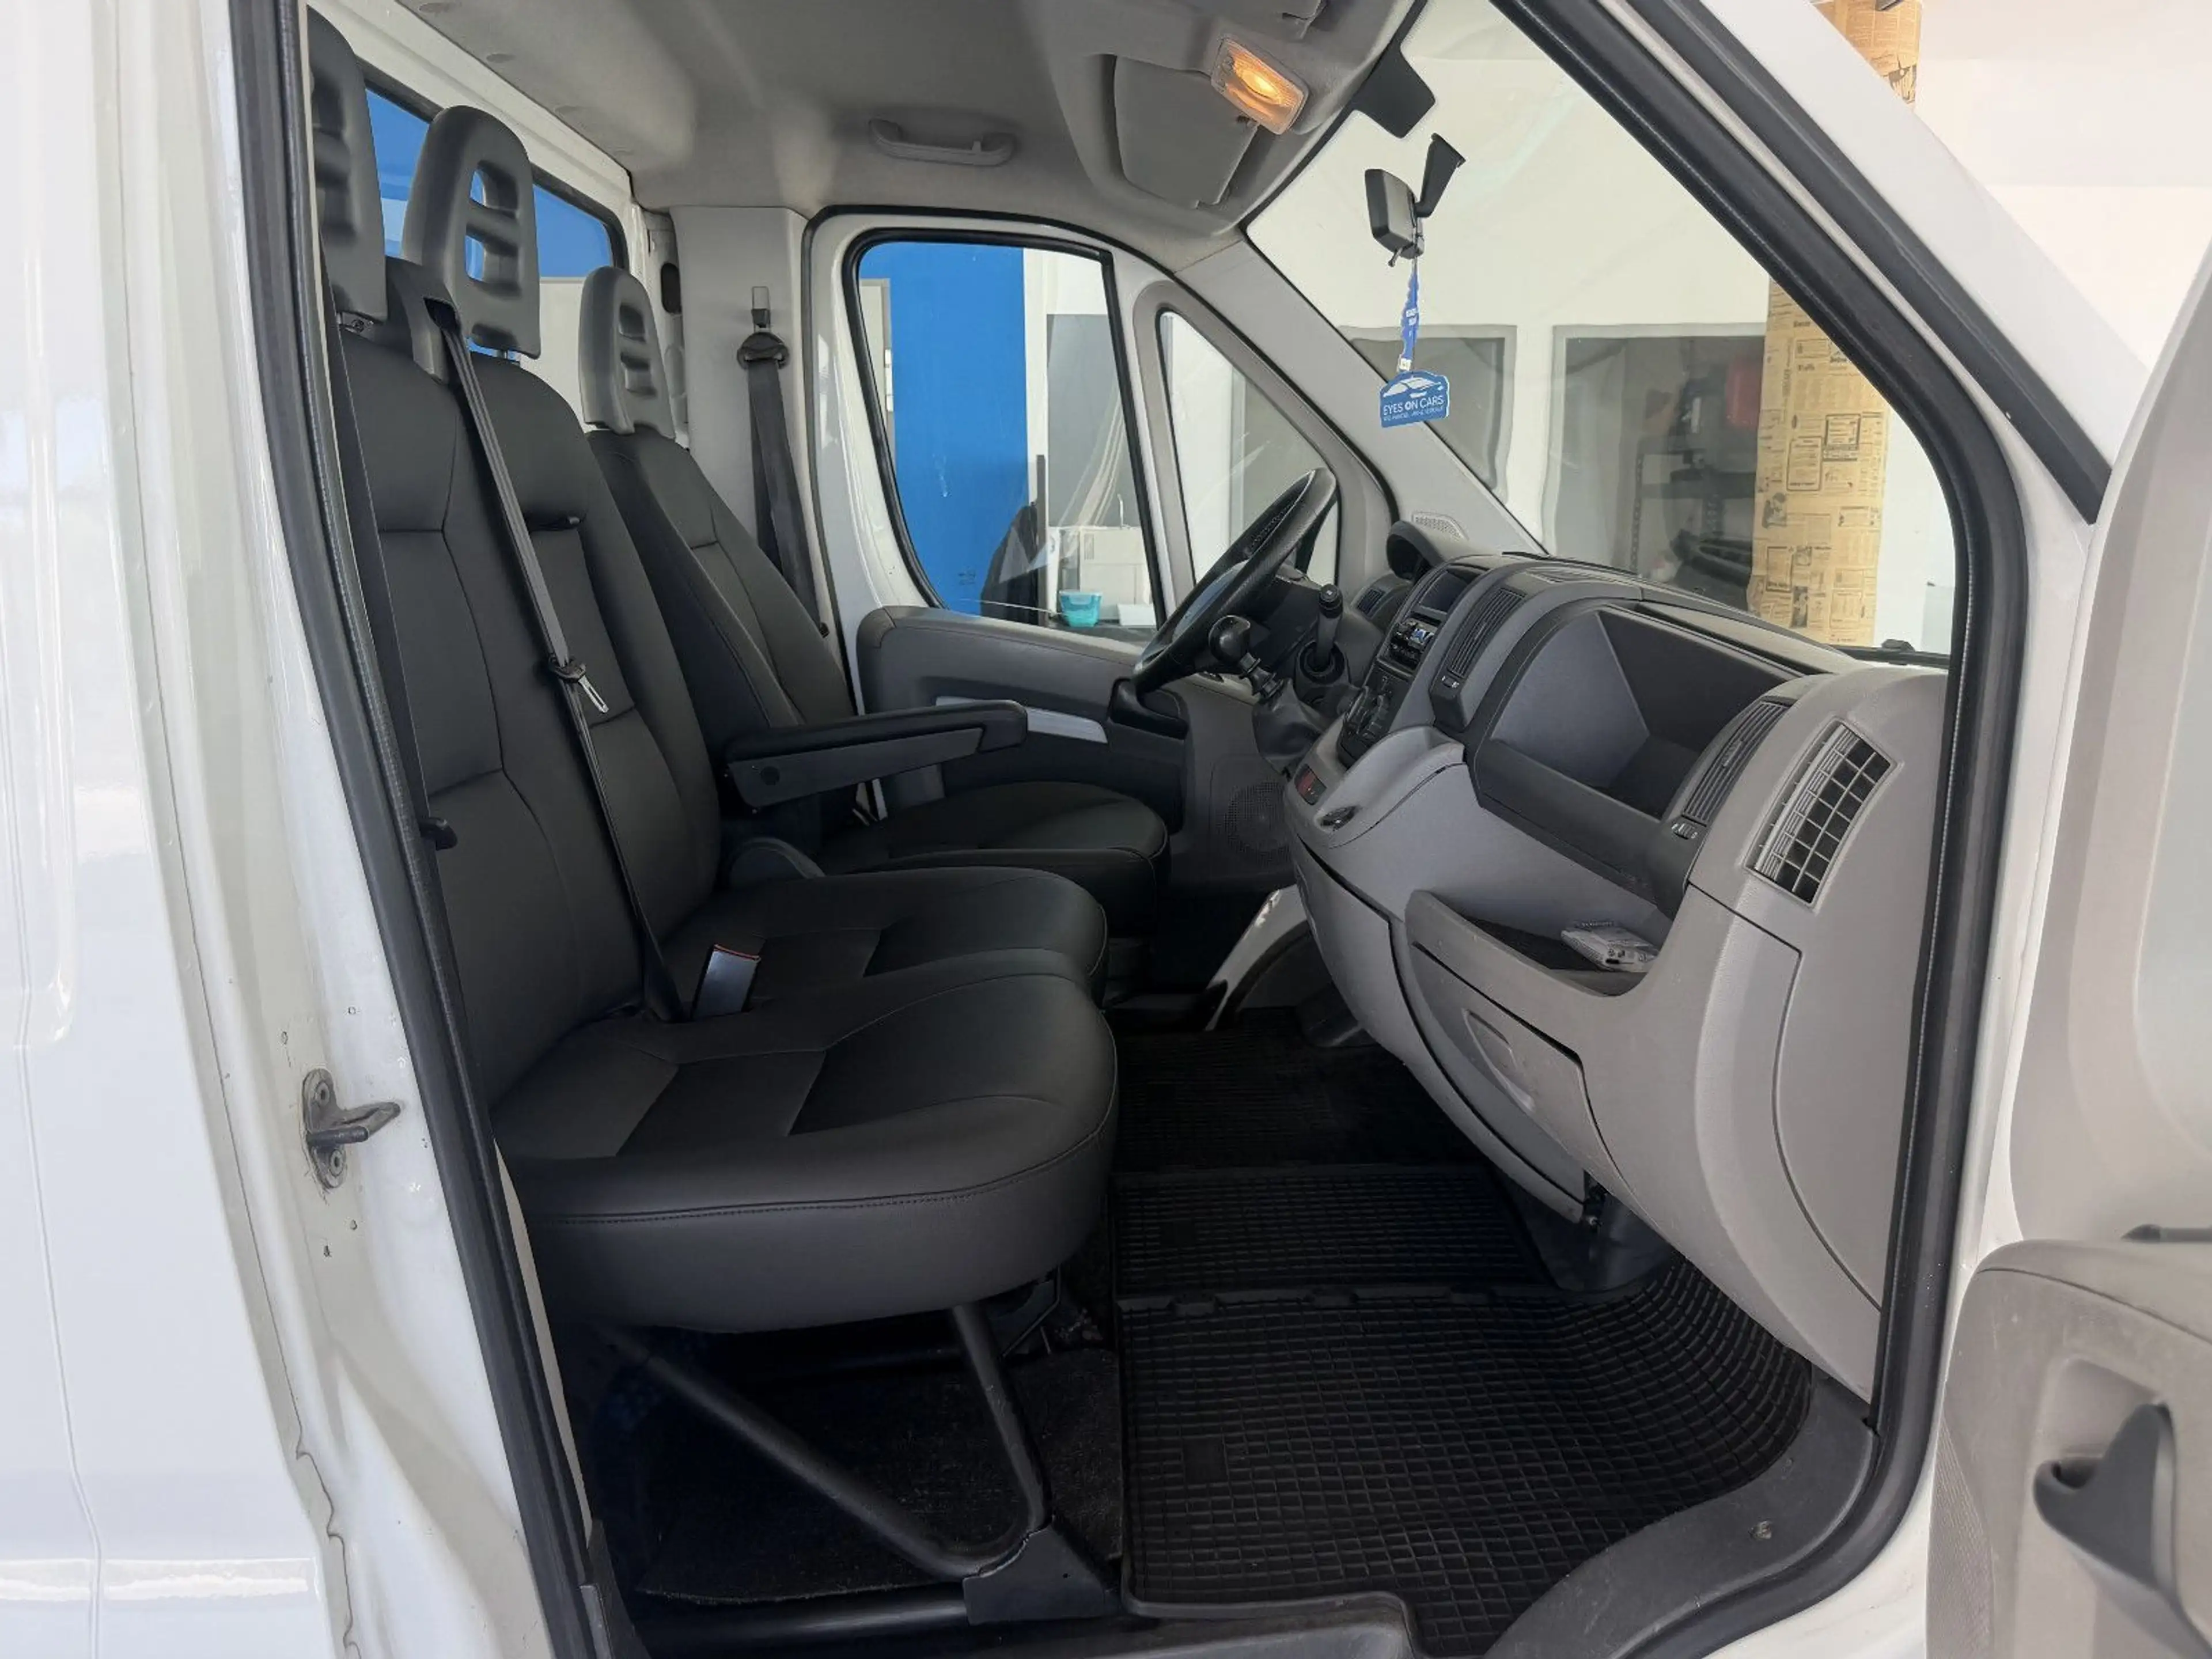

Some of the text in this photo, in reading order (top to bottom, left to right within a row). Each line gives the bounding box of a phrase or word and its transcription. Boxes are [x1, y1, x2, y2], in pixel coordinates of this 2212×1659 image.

[1384, 403, 1403, 415] EYES
[1405, 400, 1418, 410] ON
[1420, 395, 1444, 408] CARS
